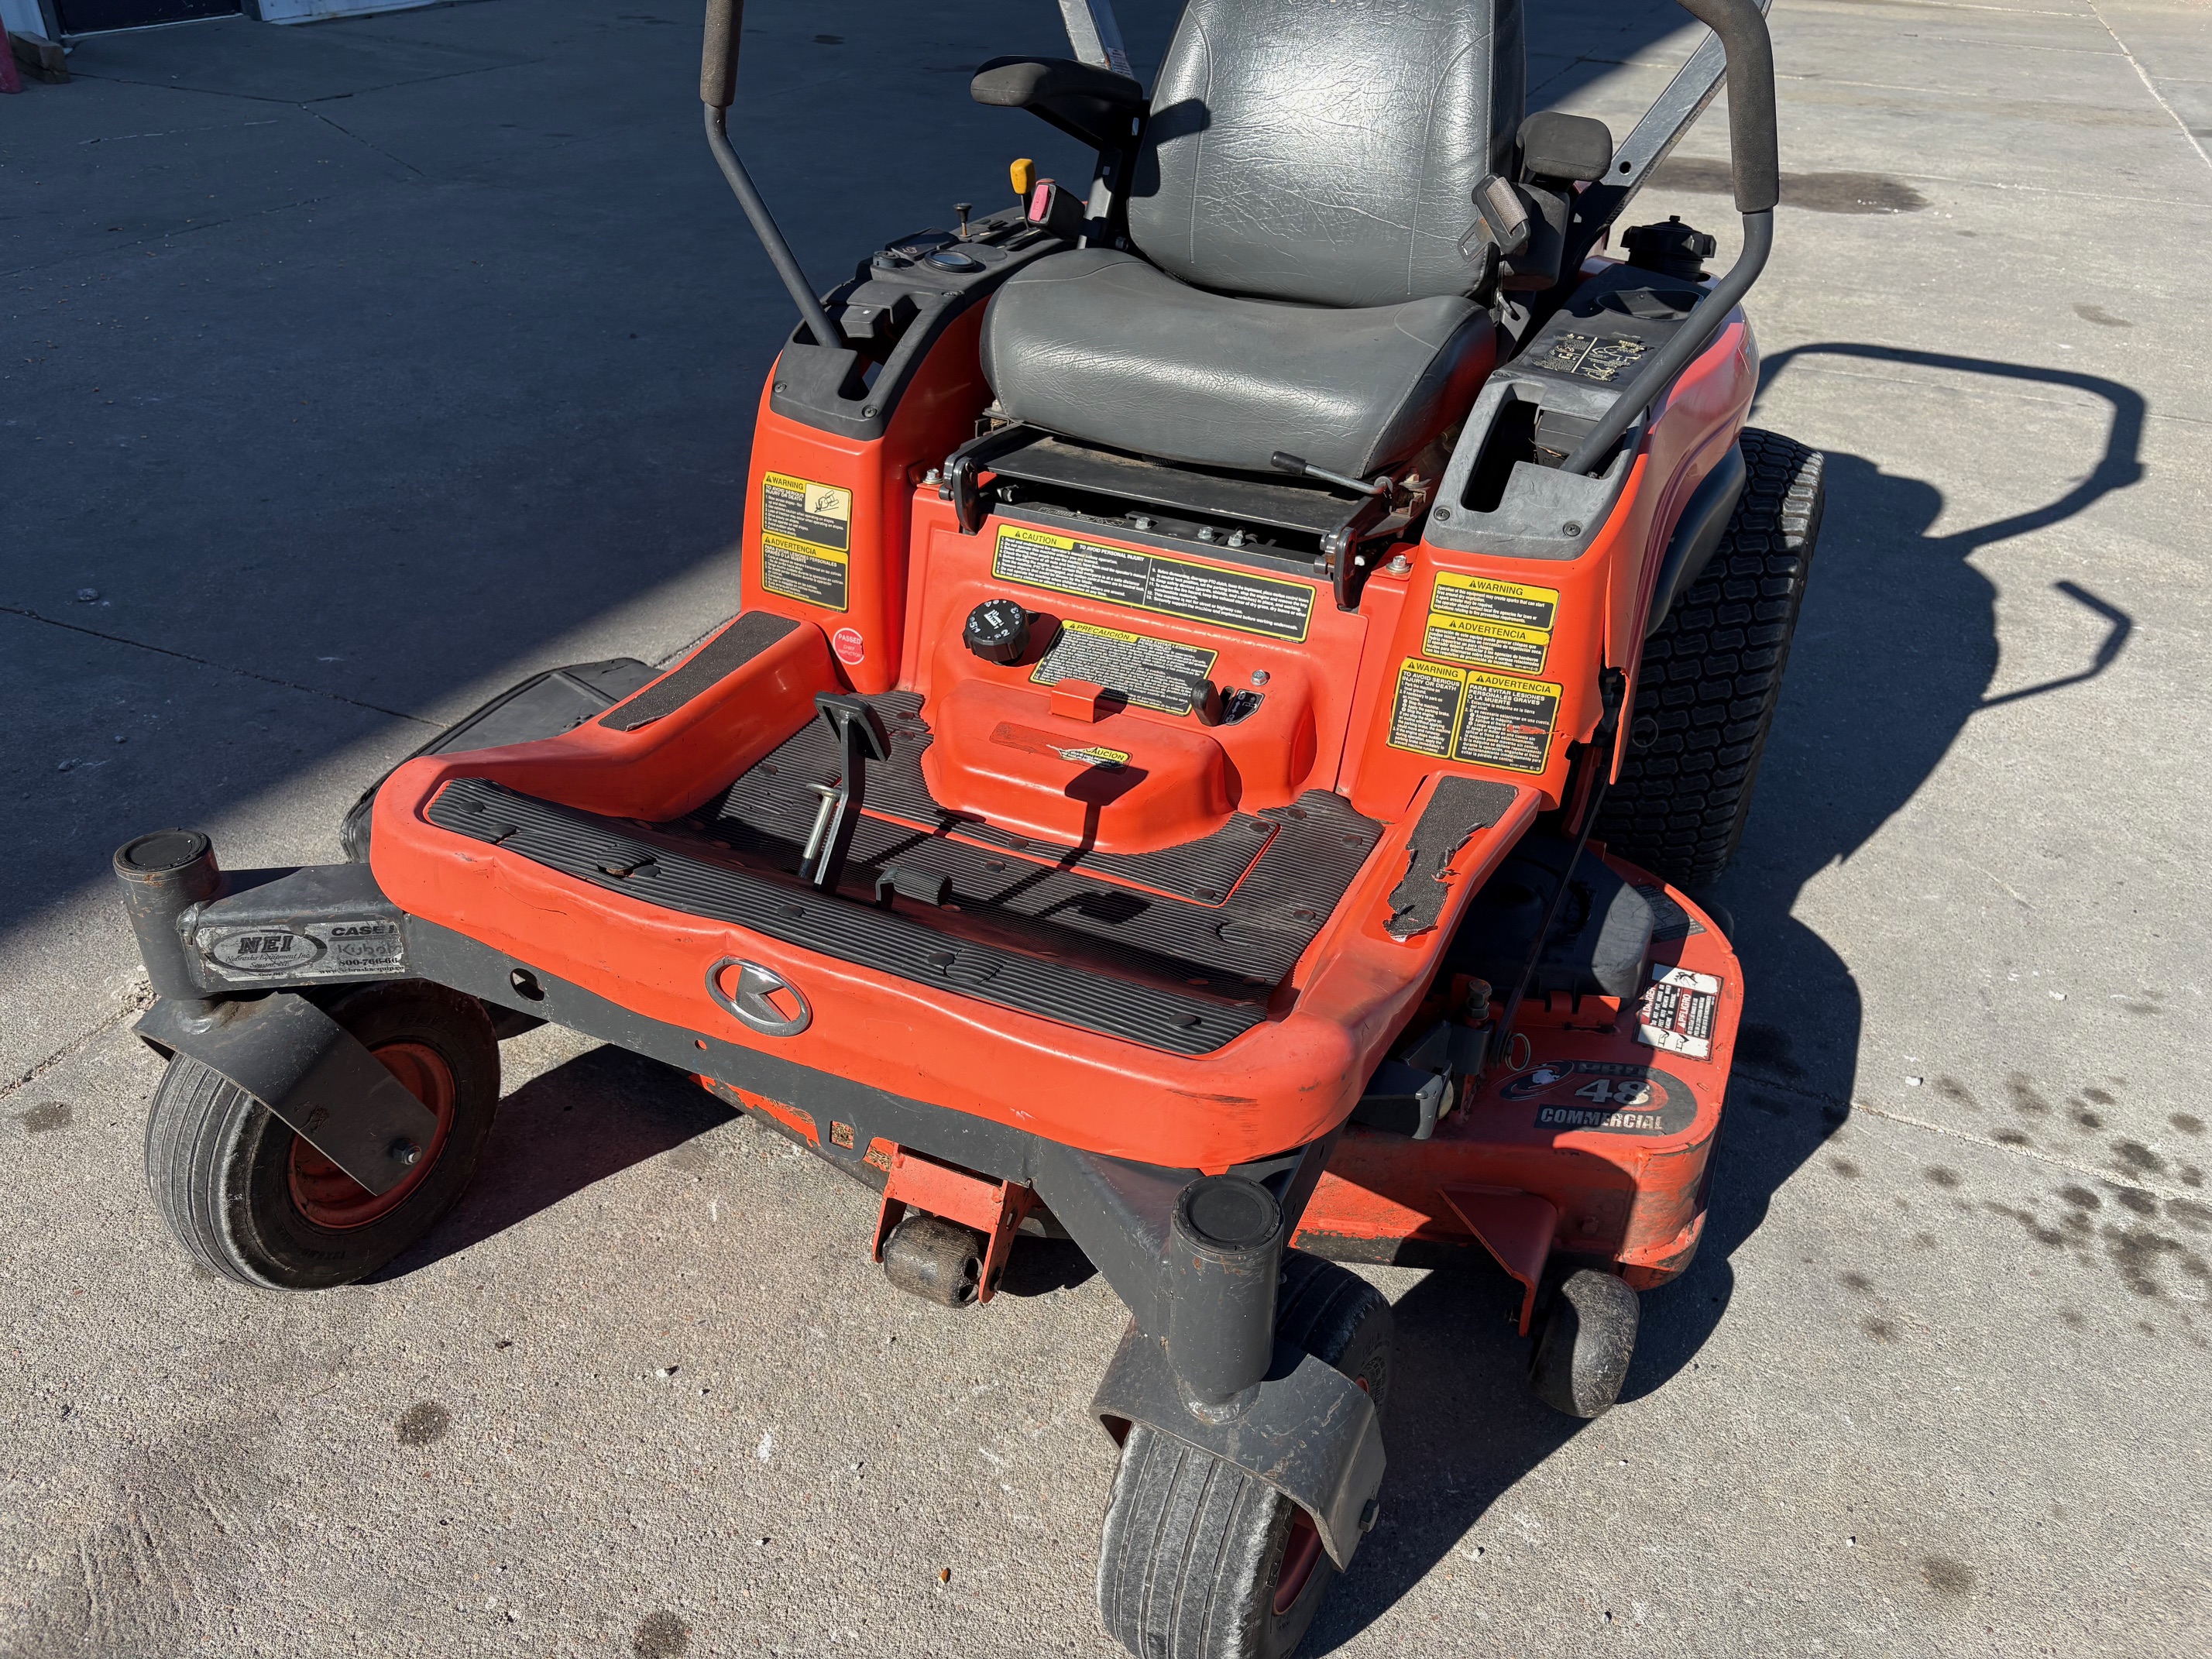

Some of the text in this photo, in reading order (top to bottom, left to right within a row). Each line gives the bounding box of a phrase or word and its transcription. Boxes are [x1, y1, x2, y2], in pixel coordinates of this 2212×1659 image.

[772, 477, 803, 489] WARNING
[1022, 532, 1056, 544] CAUTION
[771, 538, 816, 555] ADVERTENCIA
[1102, 549, 1125, 558] PERSONAL
[809, 556, 836, 566] PERSONALES
[1478, 582, 1523, 595] WARNING
[1077, 625, 1129, 639] PRECAUCIÓN
[1458, 622, 1525, 638] ADVERTENCIA
[838, 633, 861, 644] PASSED
[1417, 663, 1458, 677] WARNING
[1402, 675, 1424, 684] INJURY
[1433, 677, 1459, 686] SERIOUS
[1486, 677, 1550, 692] ADVERTENCIA
[1468, 689, 1540, 705] PERSONALES GRAVES
[1484, 696, 1510, 705] MUERTE
[1512, 692, 1544, 700] LESIONES
[331, 926, 384, 936] CASE
[235, 936, 294, 953] NEI
[1575, 1079, 1650, 1105] 48
[1540, 1107, 1664, 1130] COMMERCIAL
